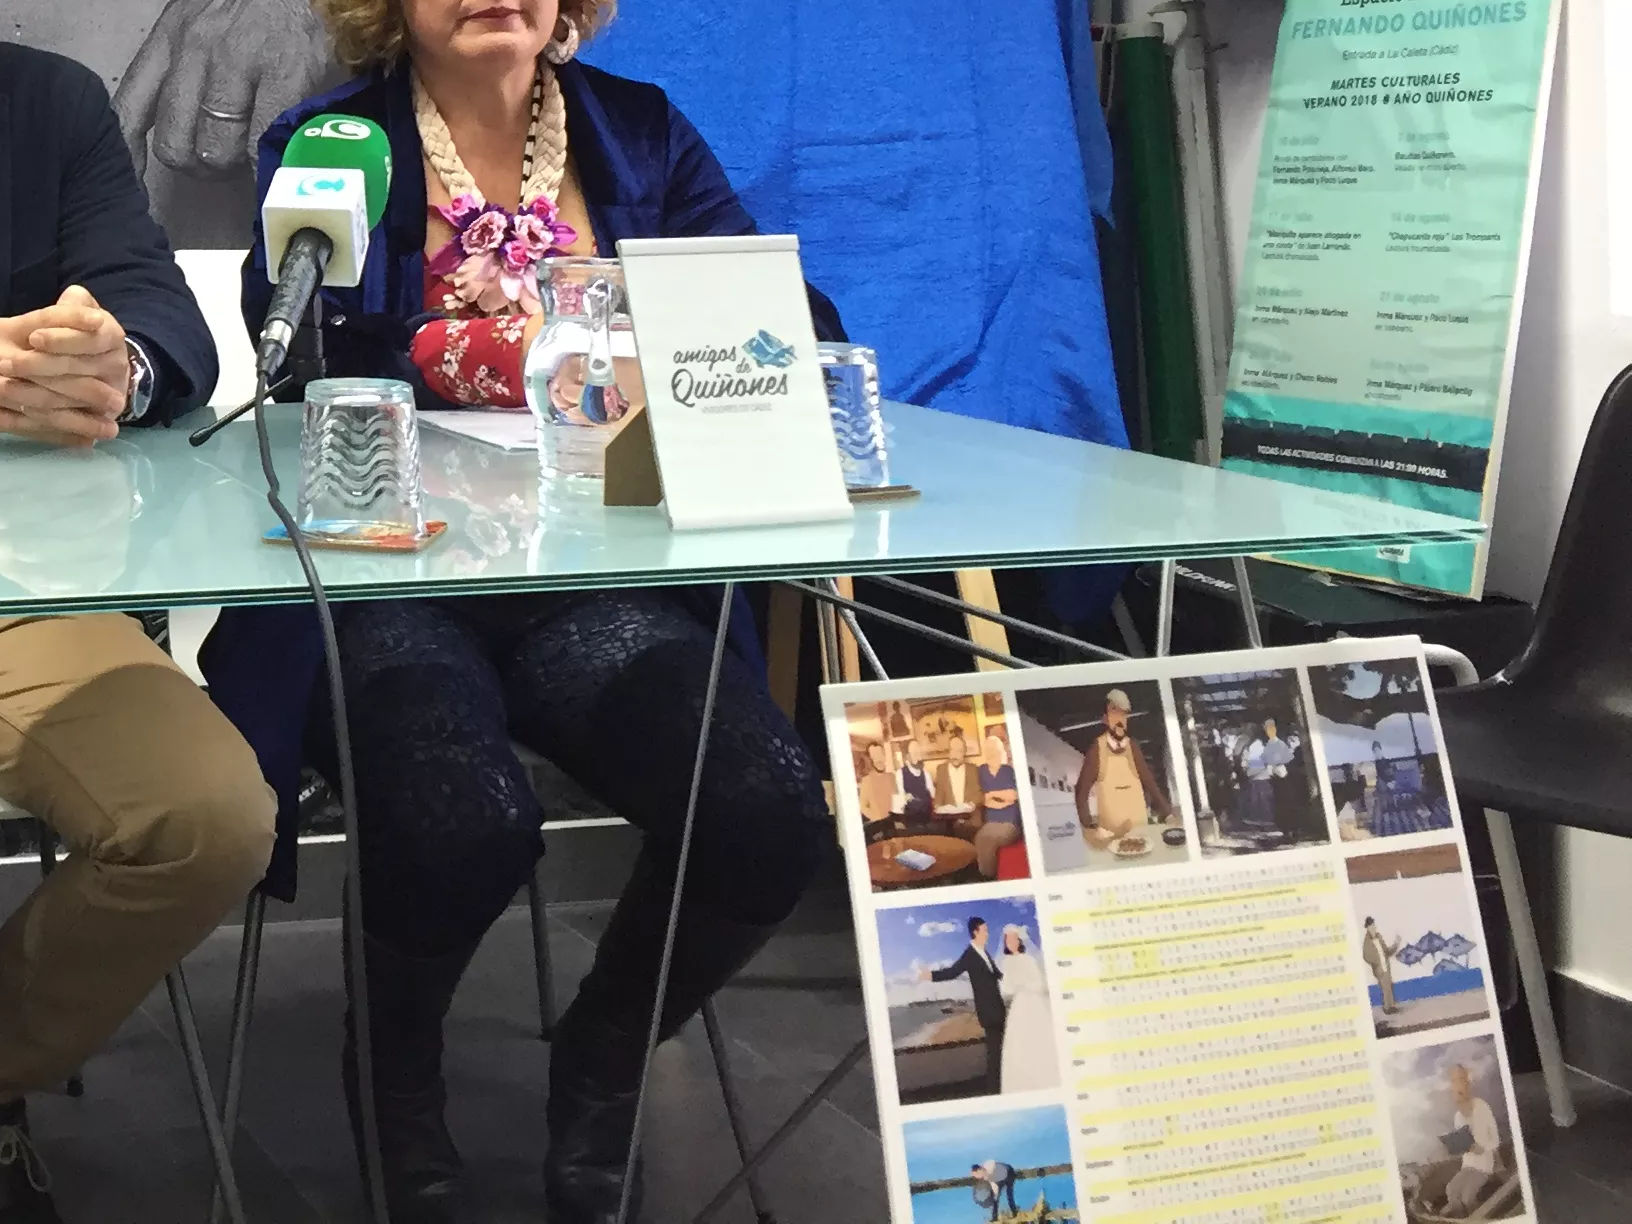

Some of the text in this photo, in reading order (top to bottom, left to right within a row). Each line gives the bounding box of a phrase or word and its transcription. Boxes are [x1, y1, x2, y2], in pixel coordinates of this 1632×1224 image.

[1292, 0, 1527, 39] FERNANDO QUIÑONES
[1330, 73, 1461, 90] MARTES CULTURALES
[1303, 95, 1347, 109] VERANO
[1351, 94, 1377, 106] 2018
[1394, 90, 1422, 105] AÑO
[1426, 87, 1494, 104] QUIÑONES
[673, 344, 737, 371] amigos
[736, 357, 752, 374] de
[670, 367, 789, 408] Quiñones
